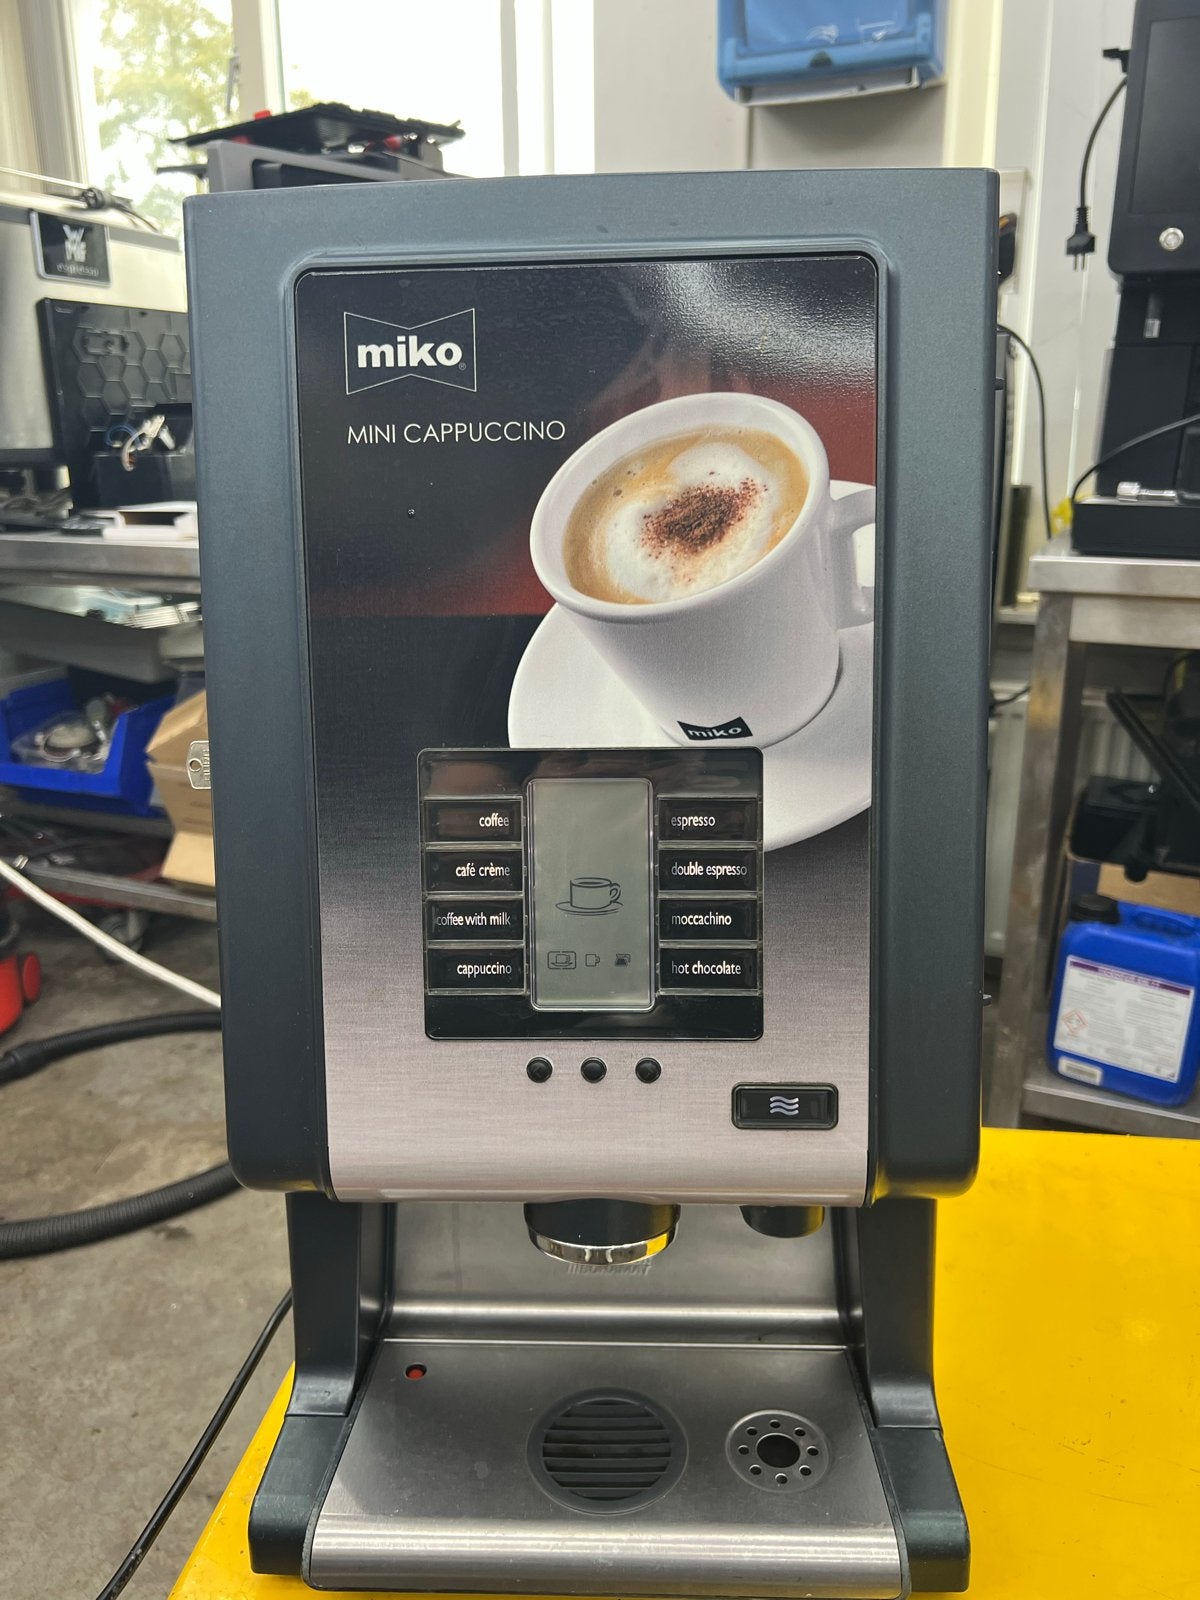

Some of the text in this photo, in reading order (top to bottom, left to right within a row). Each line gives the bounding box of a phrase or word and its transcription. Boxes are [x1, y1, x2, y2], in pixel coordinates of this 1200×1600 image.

[357, 335, 463, 369] miko
[347, 420, 566, 444] MINI CAPPUCCINO
[687, 727, 742, 737] miko
[479, 812, 510, 828] coffee
[671, 815, 716, 831] espresso
[455, 862, 511, 877] café crème
[671, 861, 748, 879] double espresso
[436, 911, 511, 926] coffee with milk
[671, 911, 732, 926] moccachino
[456, 961, 512, 979] cappuccino
[671, 960, 742, 975] hot chocolate
